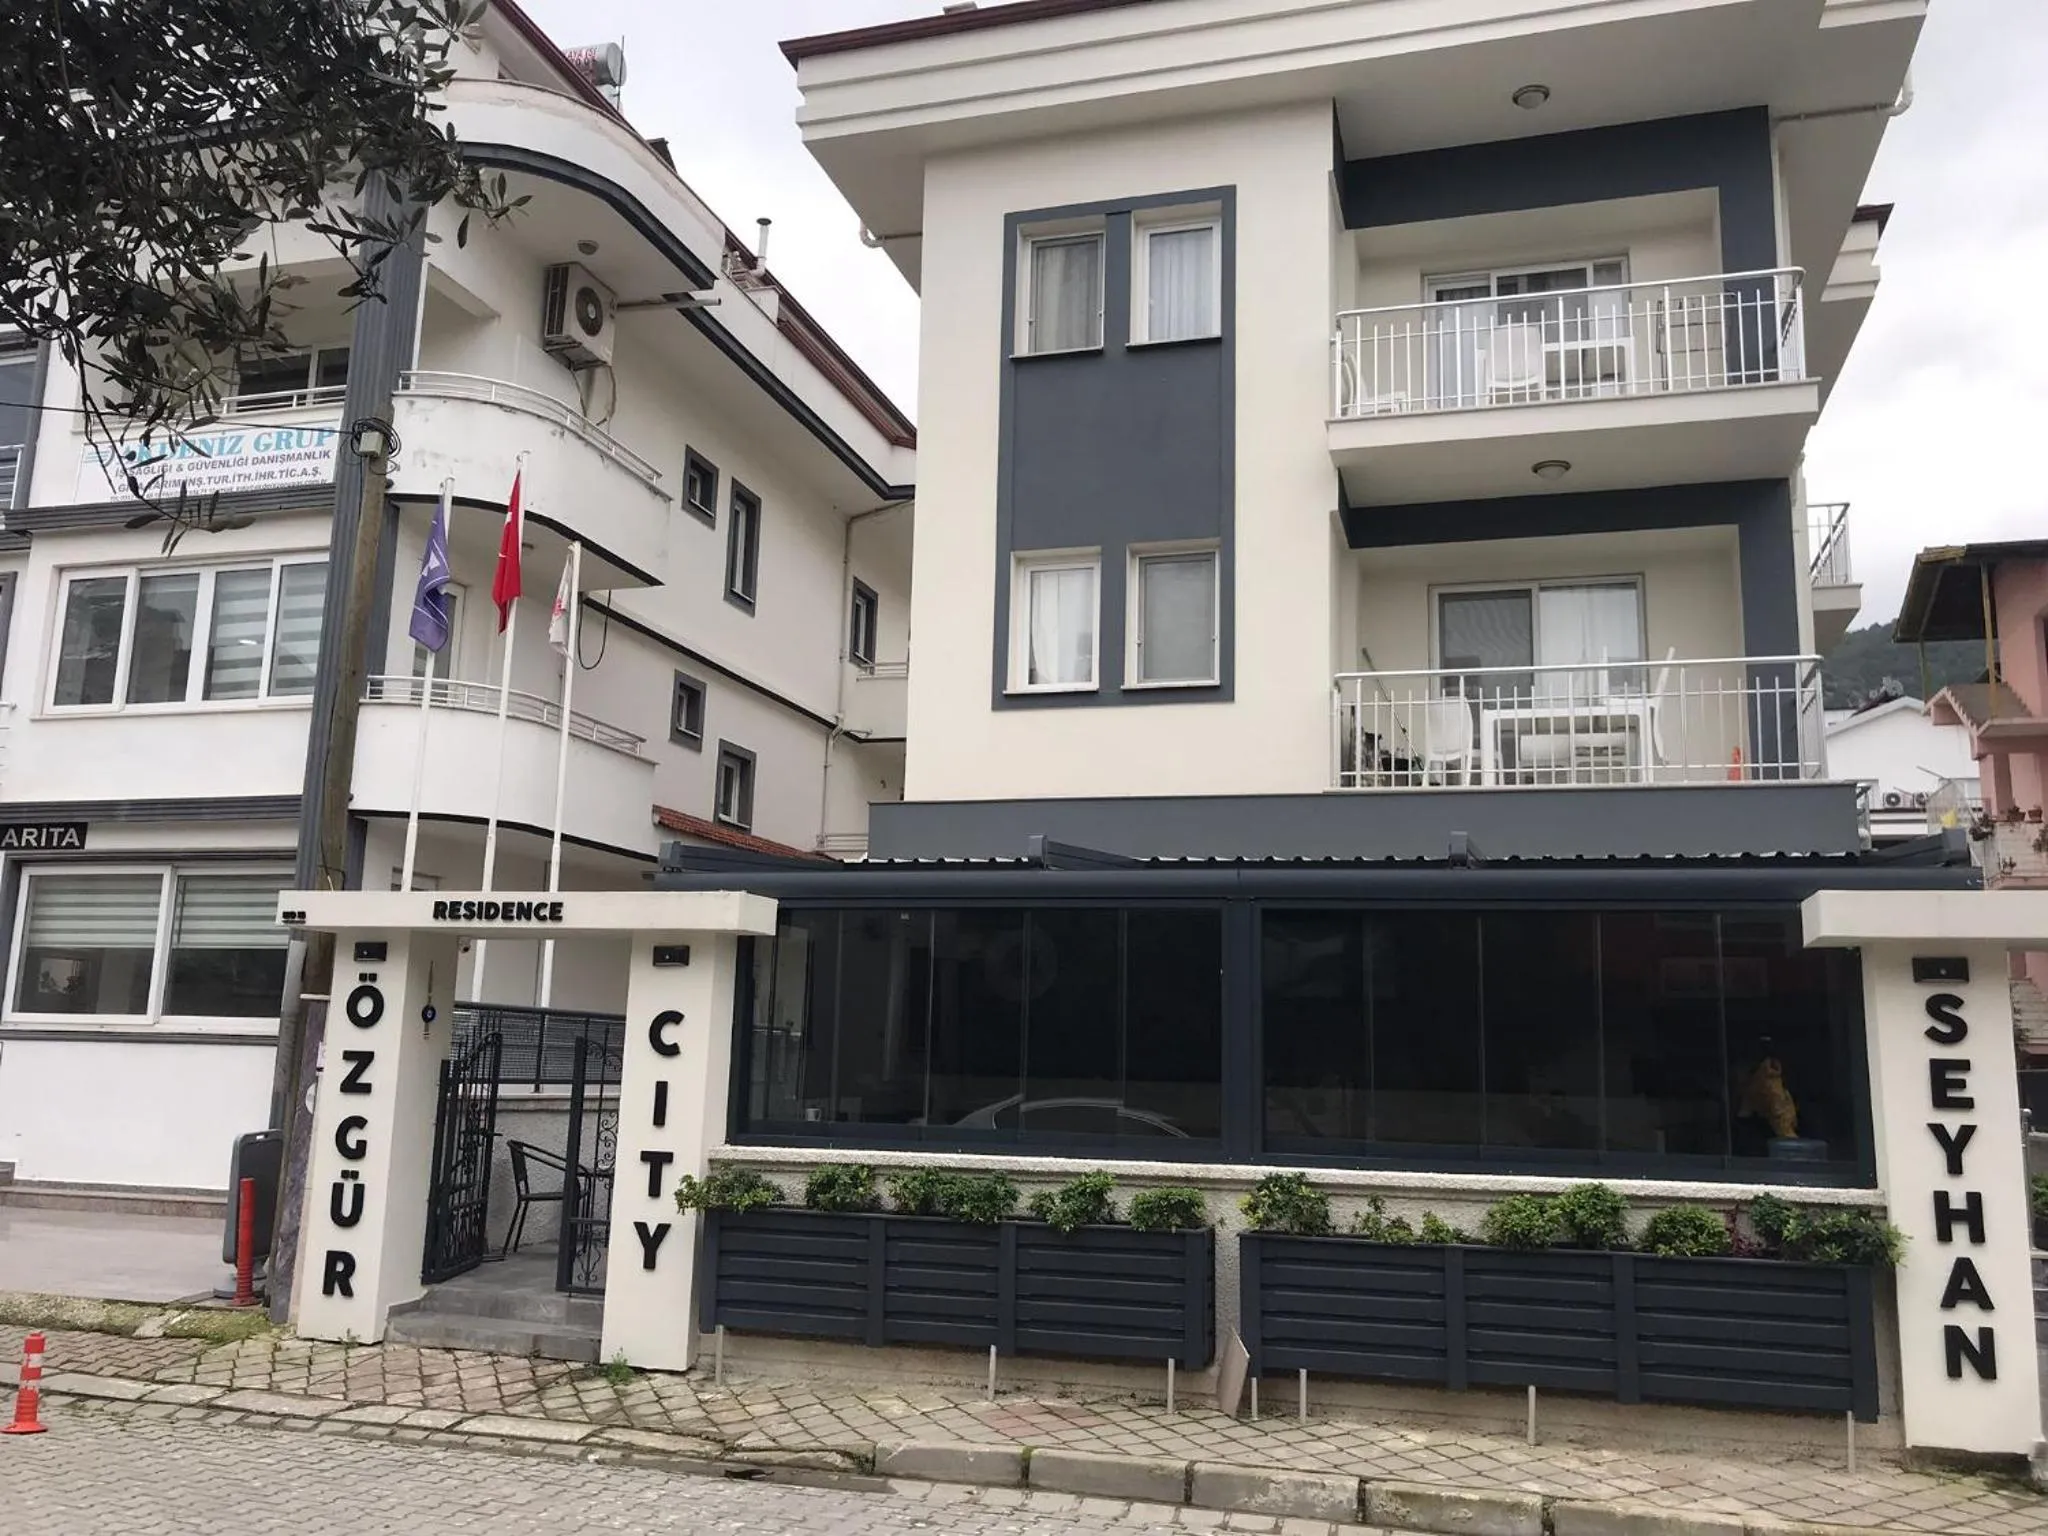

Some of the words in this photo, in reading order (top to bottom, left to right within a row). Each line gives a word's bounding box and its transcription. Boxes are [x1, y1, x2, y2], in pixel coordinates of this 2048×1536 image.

[176, 463, 184, 472] &
[251, 449, 331, 466] DANIŞMANLIK
[253, 426, 335, 453] GRUP
[433, 900, 564, 922] RESIDENCE
[321, 972, 386, 1298] ÖZGÜR
[634, 1010, 686, 1270] CITY
[1924, 993, 1998, 1380] SEYHAN
